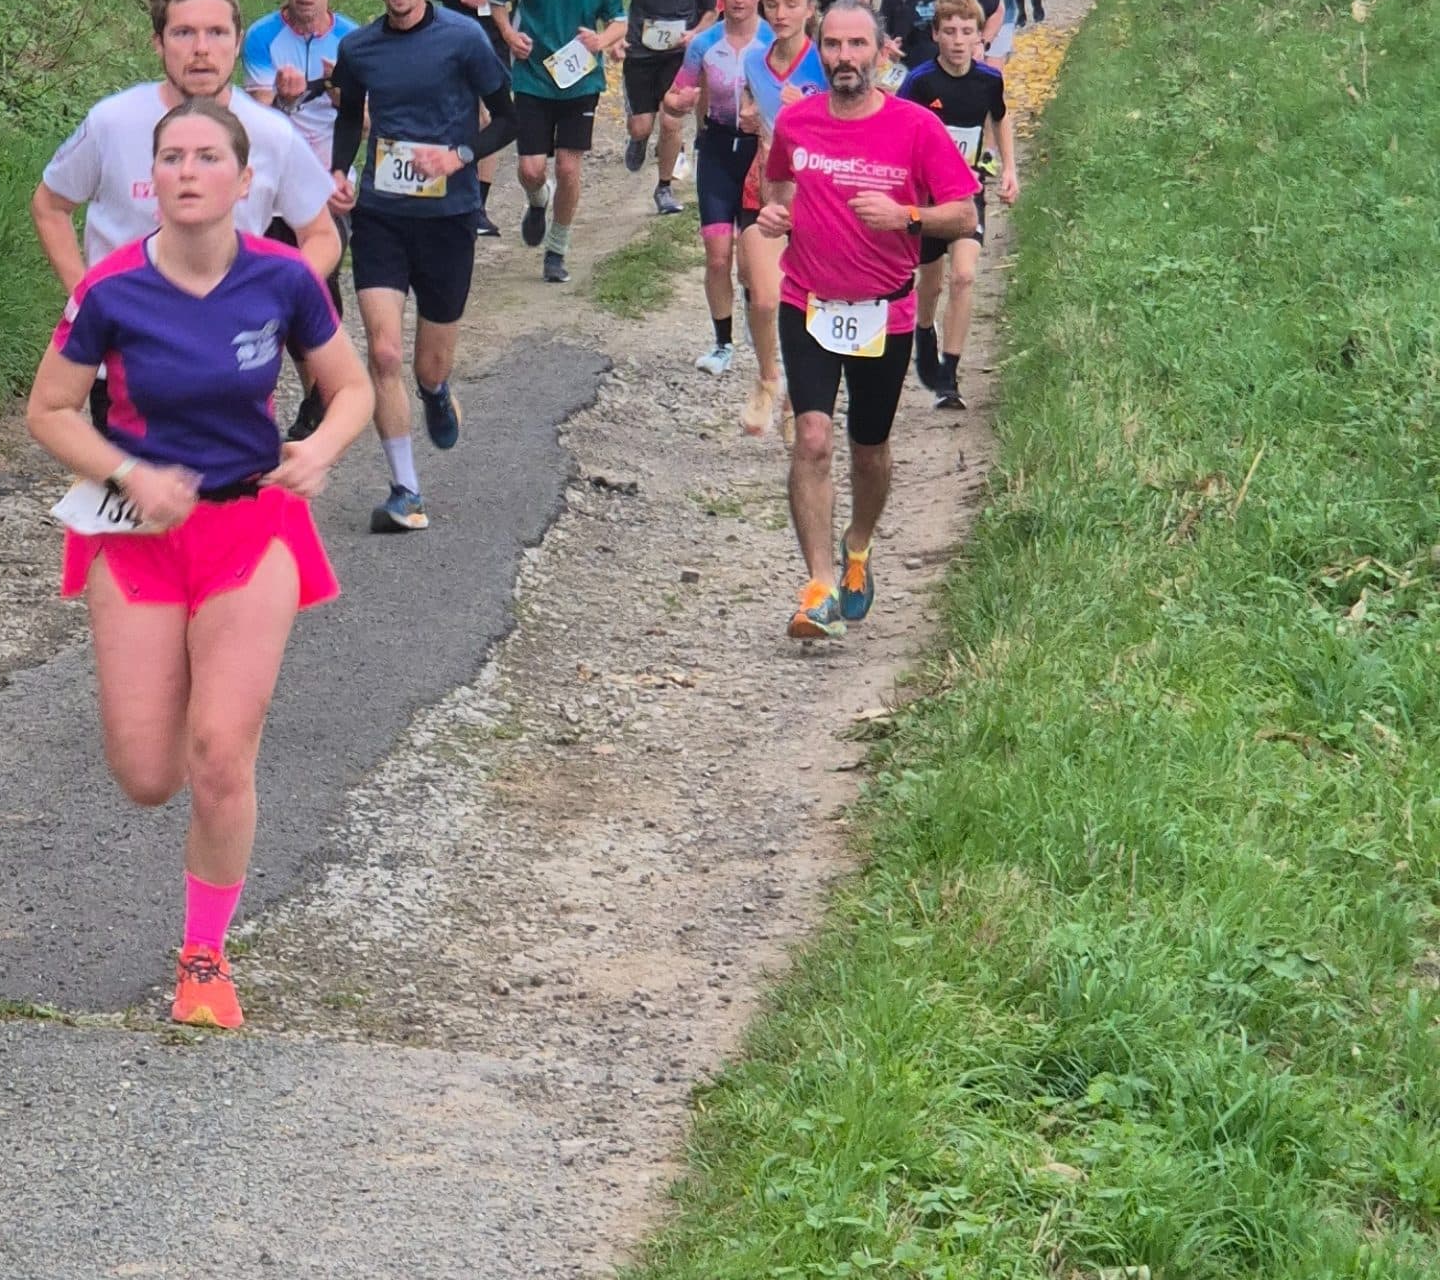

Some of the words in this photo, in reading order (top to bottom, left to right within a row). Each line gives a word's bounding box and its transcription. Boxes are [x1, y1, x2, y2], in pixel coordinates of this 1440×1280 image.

[657, 30, 671, 44] 72
[564, 54, 582, 73] 87
[808, 153, 909, 179] DigestScience
[832, 315, 858, 341] 86
